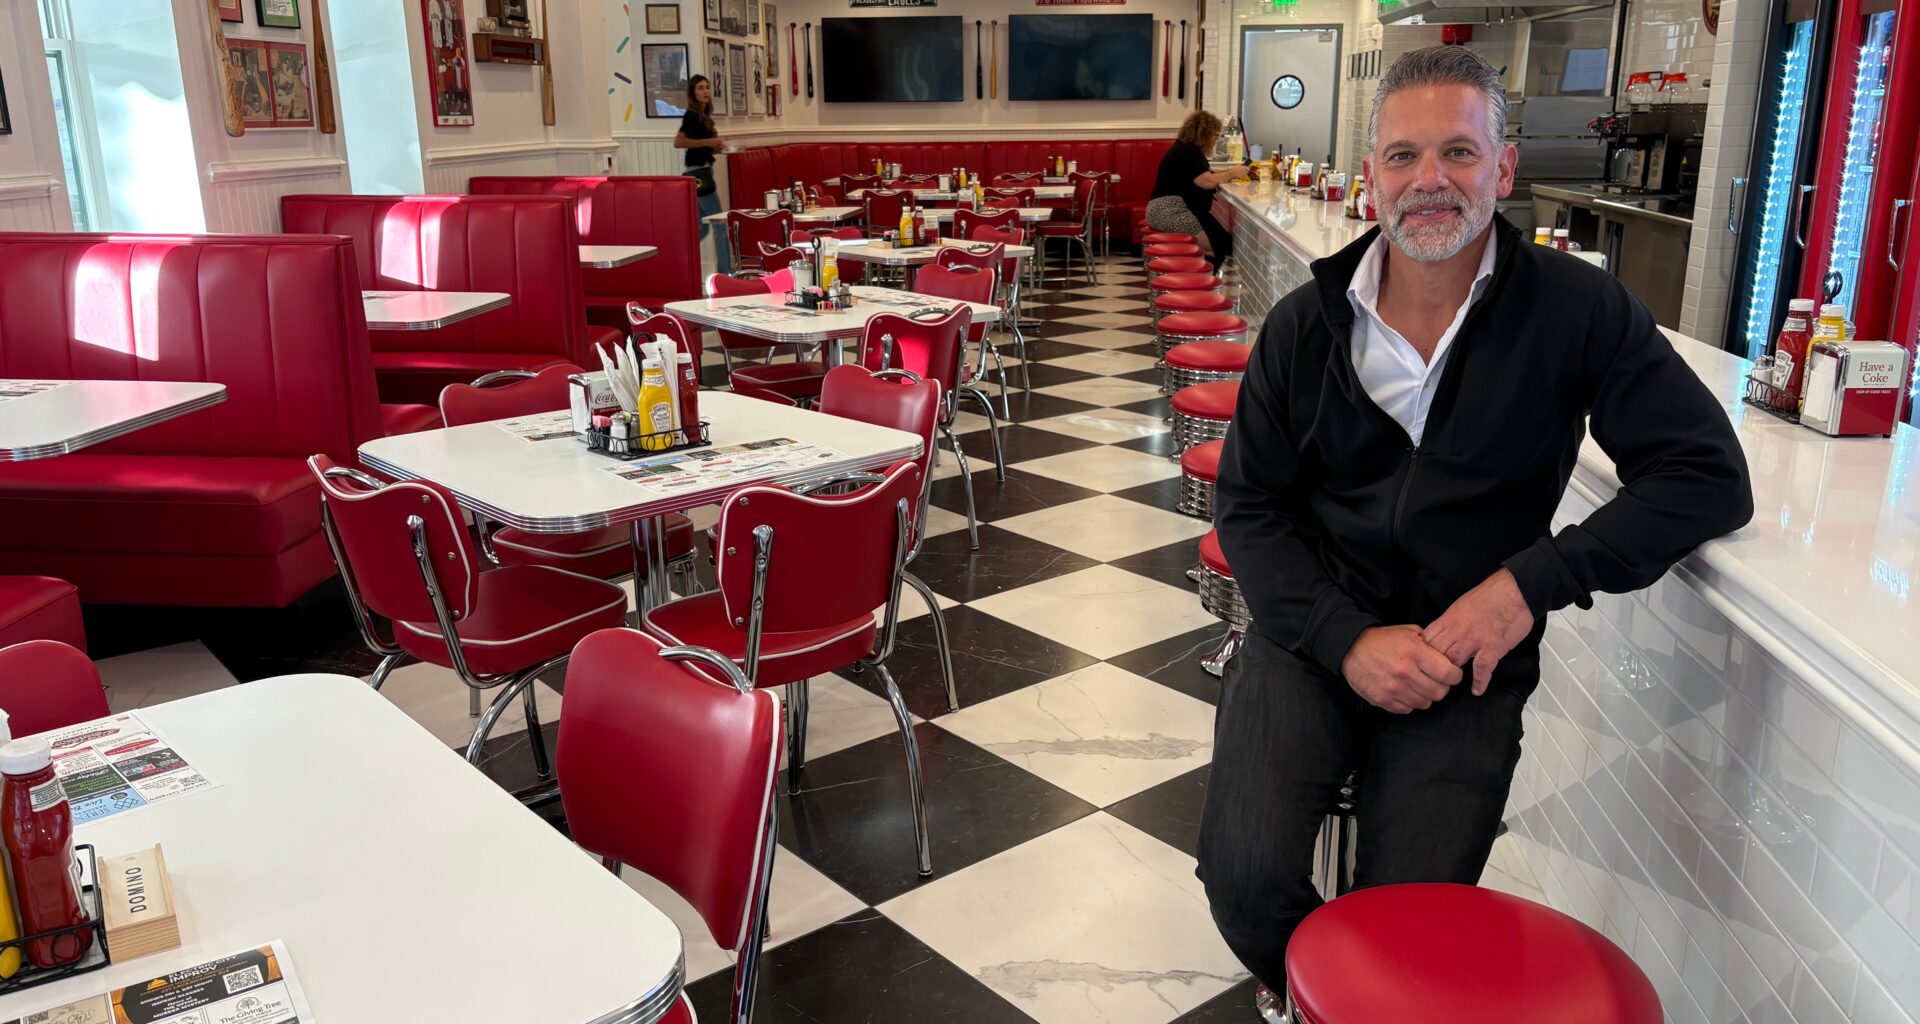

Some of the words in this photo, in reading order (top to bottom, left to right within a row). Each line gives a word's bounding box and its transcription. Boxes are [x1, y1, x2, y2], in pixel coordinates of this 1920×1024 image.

[1859, 361, 1885, 372] Have
[1888, 364, 1894, 372] a
[1862, 372, 1889, 383] Coke
[126, 868, 147, 913] DOMINO
[169, 964, 218, 984] IMPROV
[220, 1016, 236, 1024] The
[236, 1006, 264, 1018] Giving
[264, 1001, 281, 1010] Tree
